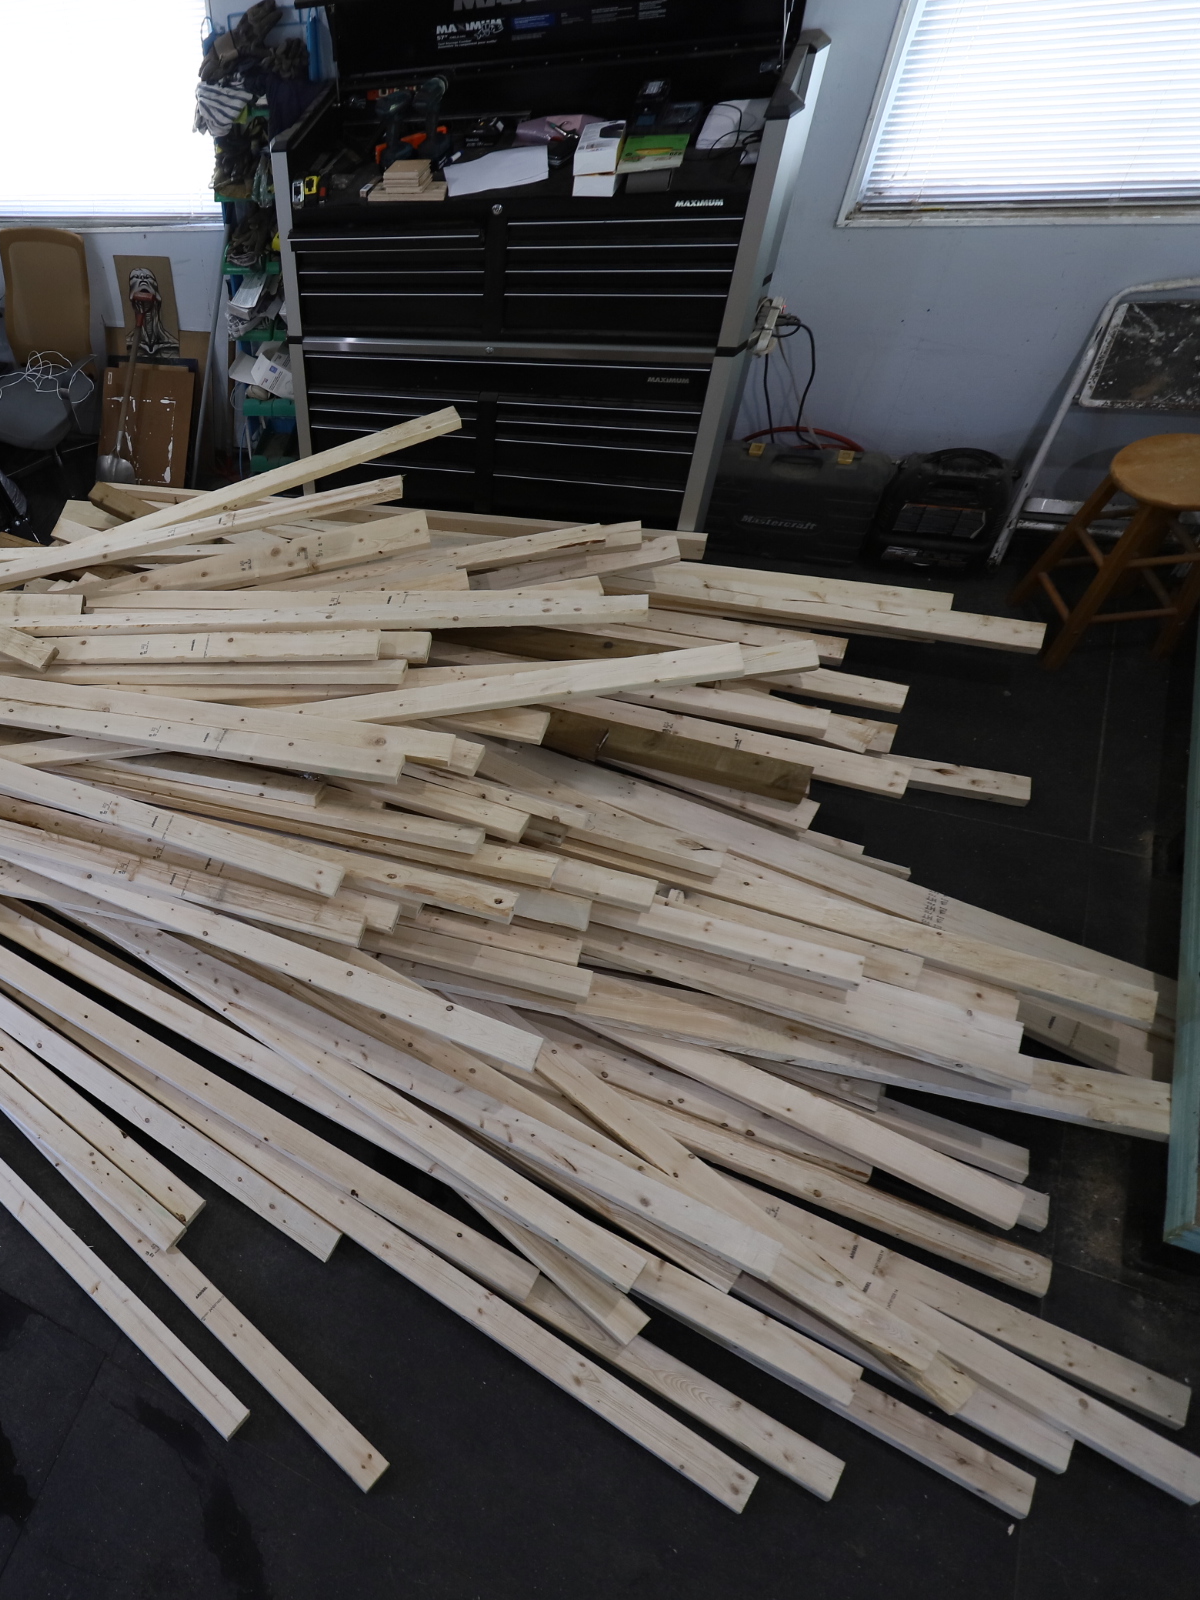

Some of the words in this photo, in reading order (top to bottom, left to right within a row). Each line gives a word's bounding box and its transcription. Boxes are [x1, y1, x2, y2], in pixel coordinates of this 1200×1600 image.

[674, 198, 724, 208] MAXIMUM
[646, 376, 690, 385] MAXIMUM
[740, 514, 818, 532] Mastercraft
